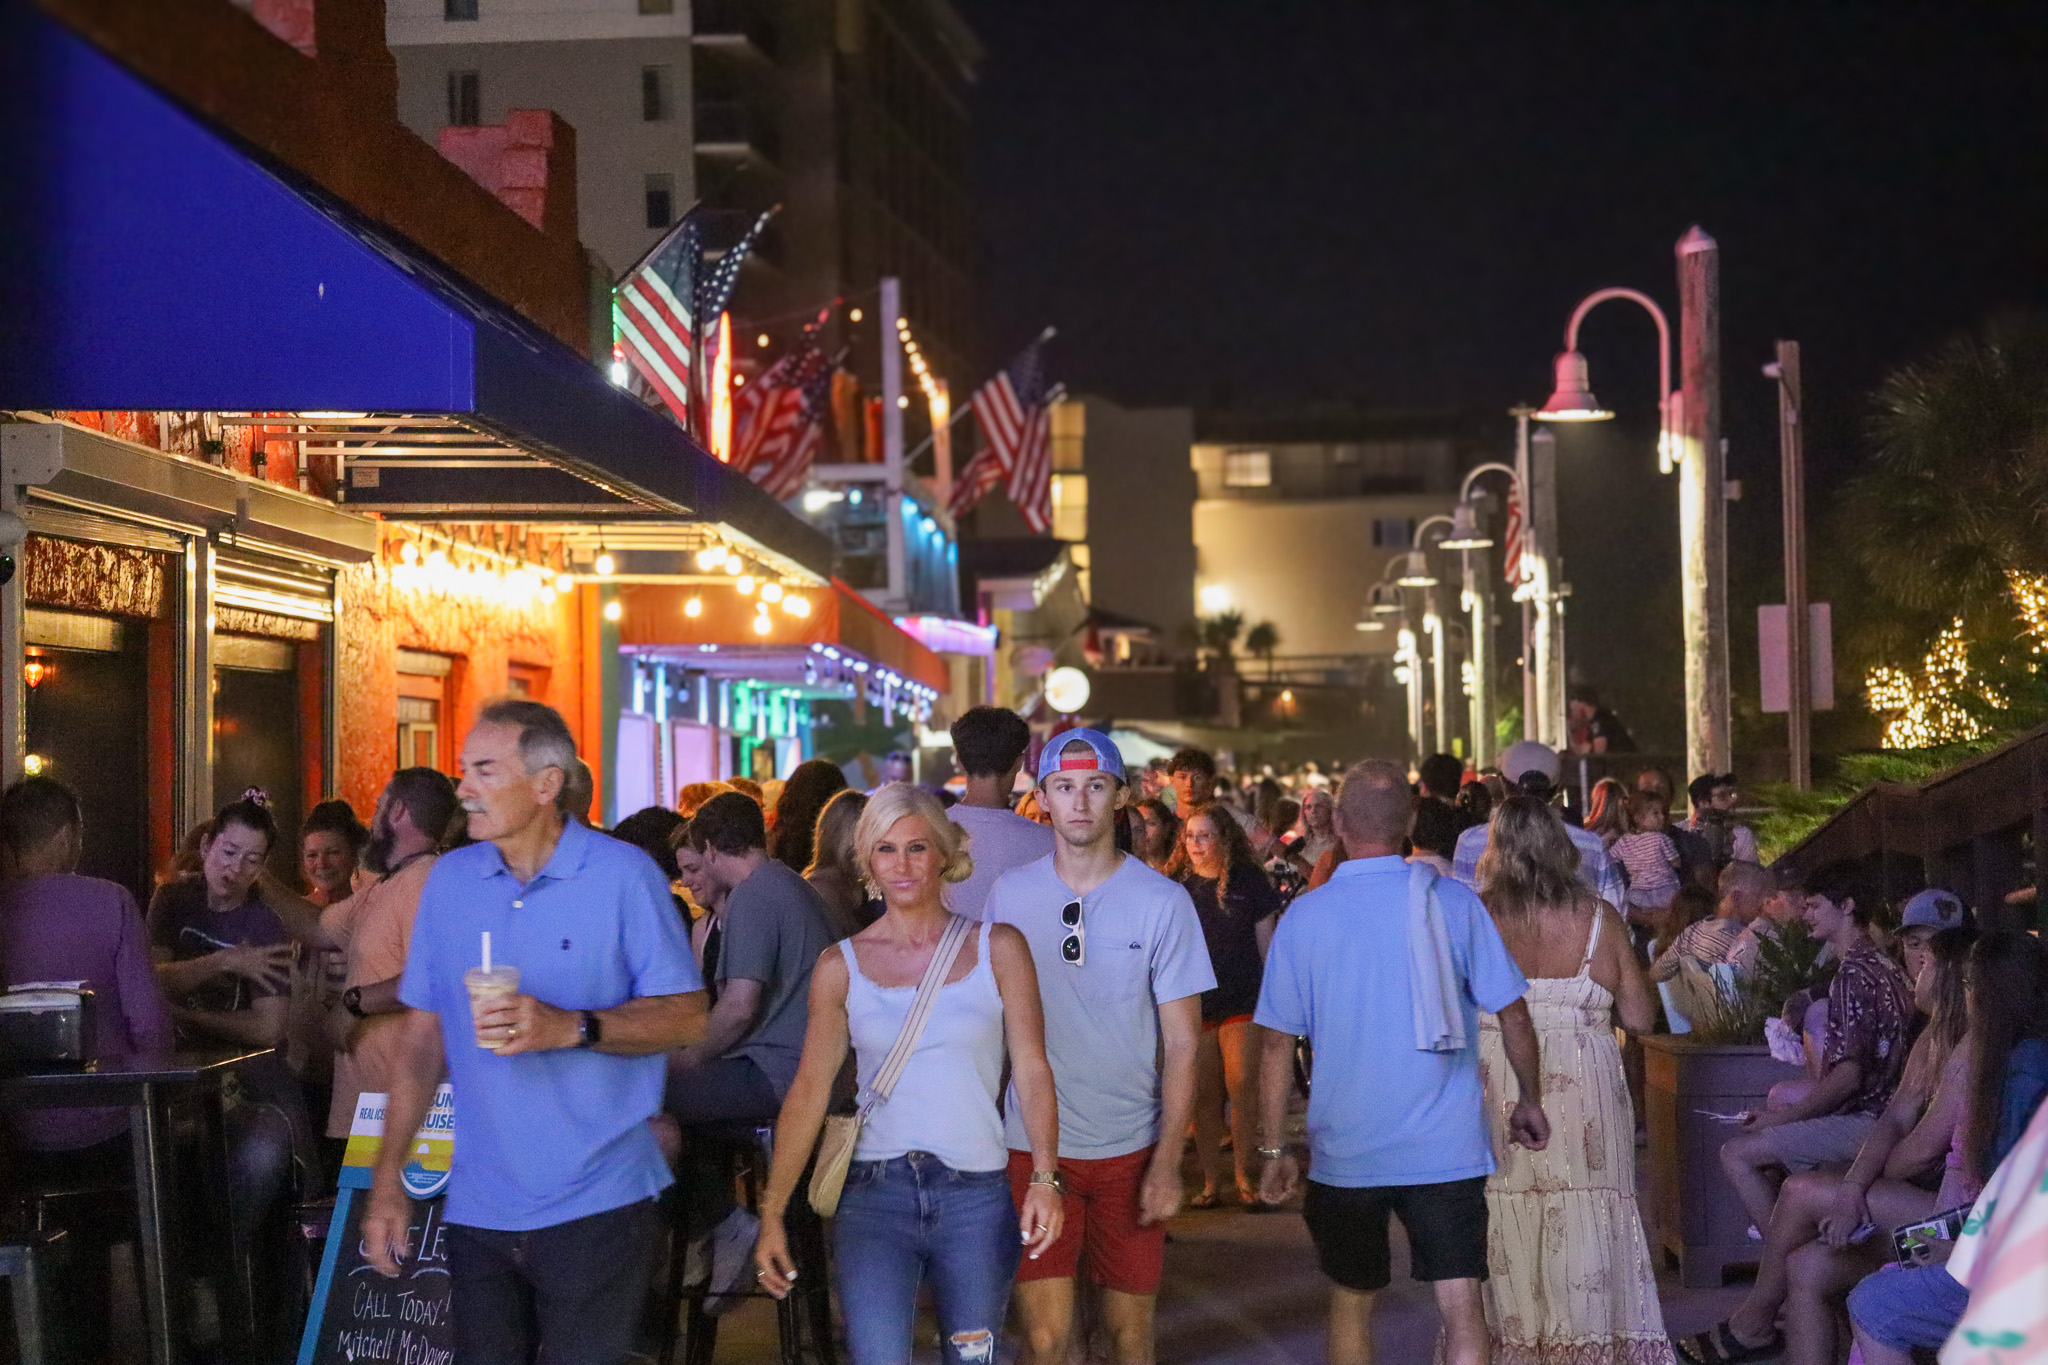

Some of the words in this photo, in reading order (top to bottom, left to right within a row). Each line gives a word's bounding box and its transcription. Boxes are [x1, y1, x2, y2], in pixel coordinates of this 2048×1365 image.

[359, 1107, 374, 1120] REAL
[418, 1205, 448, 1262] LE
[353, 1281, 391, 1320] CALL
[397, 1289, 453, 1326] TODAY!
[337, 1327, 395, 1360] Mitchell
